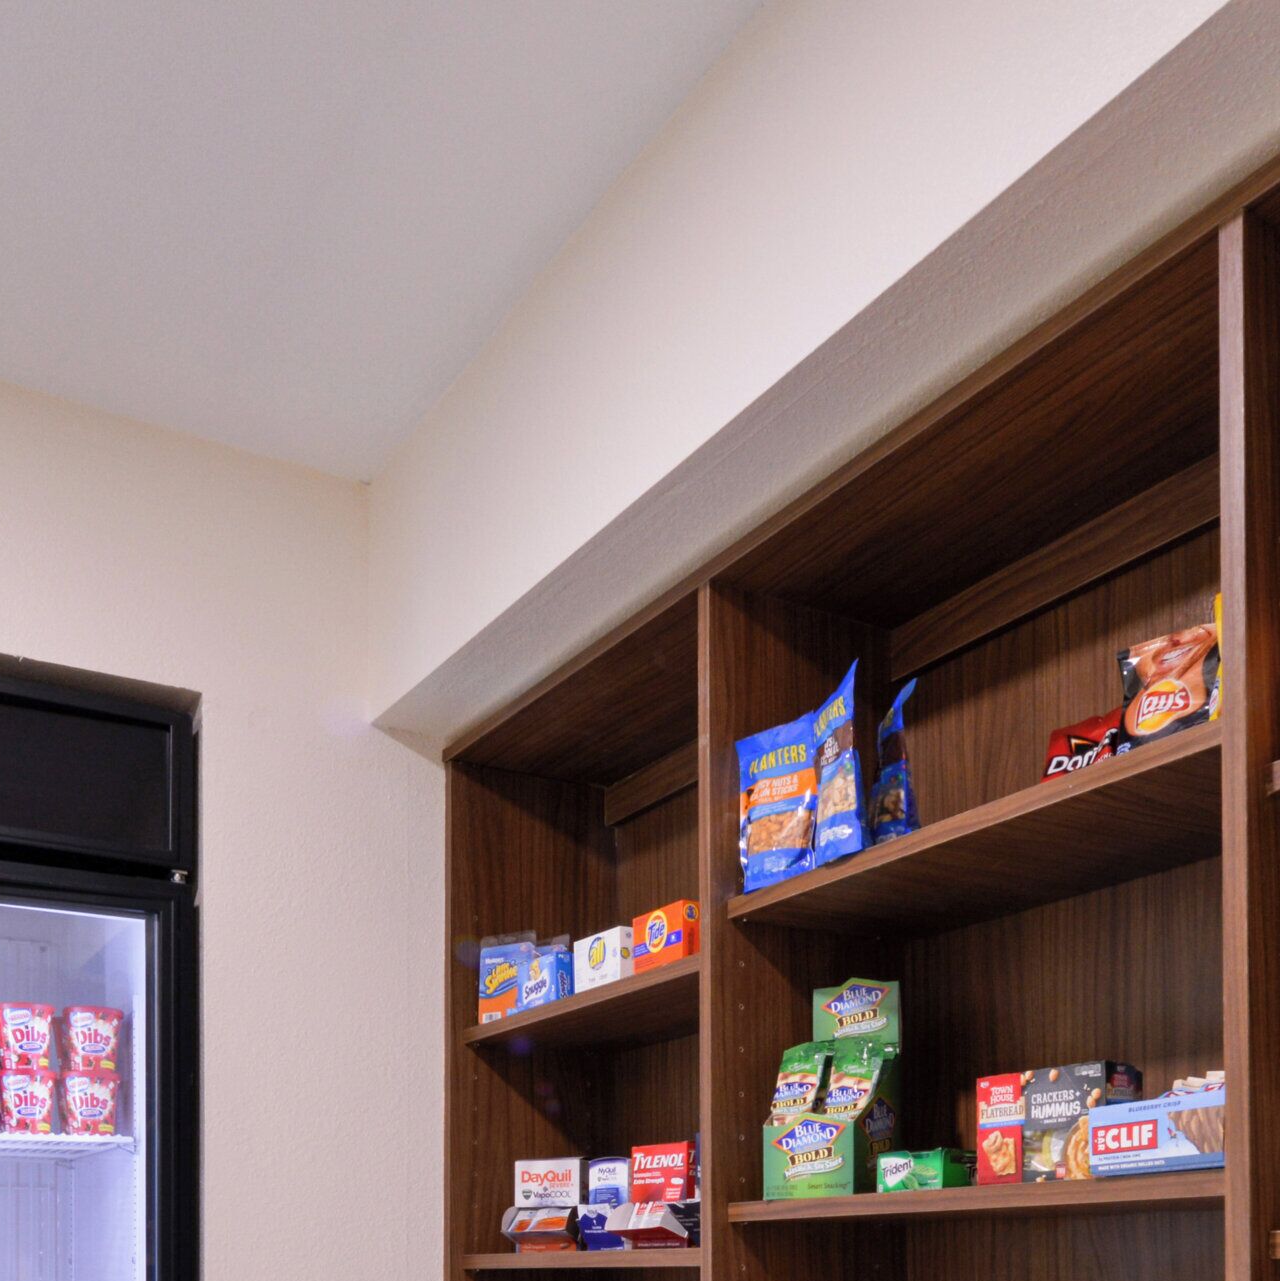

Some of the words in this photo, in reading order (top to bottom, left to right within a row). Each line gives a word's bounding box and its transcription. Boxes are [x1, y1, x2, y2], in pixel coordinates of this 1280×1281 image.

[1138, 690, 1186, 723] Lay's
[648, 922, 665, 946] Tide
[589, 938, 606, 966] all
[524, 978, 548, 1001] Snuggle
[843, 988, 869, 1001] BLUE
[830, 990, 882, 1013] DIAMOND
[842, 1010, 874, 1026] BOLD
[12, 1024, 47, 1044] Dibs
[75, 1027, 111, 1047] Dibs
[779, 1083, 800, 1092] BLUE
[991, 1085, 1013, 1095] TOWN
[14, 1090, 47, 1108] Dibs
[73, 1091, 108, 1109] Dibs
[775, 1099, 804, 1109] BOLD
[990, 1093, 1014, 1104] HOUSE
[826, 1104, 856, 1114] BOLD
[980, 1104, 1024, 1119] FLATBREAD
[1031, 1101, 1081, 1118] HUMMUS
[1128, 1103, 1162, 1113] BLUEBERRY
[782, 1126, 837, 1150] DIAMOND
[795, 1122, 822, 1138] BLUE
[1105, 1124, 1153, 1149] CLIF
[1097, 1130, 1106, 1151] BAR
[633, 1152, 684, 1171] TYLENOL
[794, 1149, 829, 1165] BOLD
[521, 1169, 572, 1185] DayQuil
[598, 1166, 617, 1175] NyQuil
[881, 1159, 912, 1179] Trident
[633, 1177, 645, 1185] Extra
[644, 1177, 665, 1185] Strength
[533, 1190, 571, 1200] VapoCOOL
